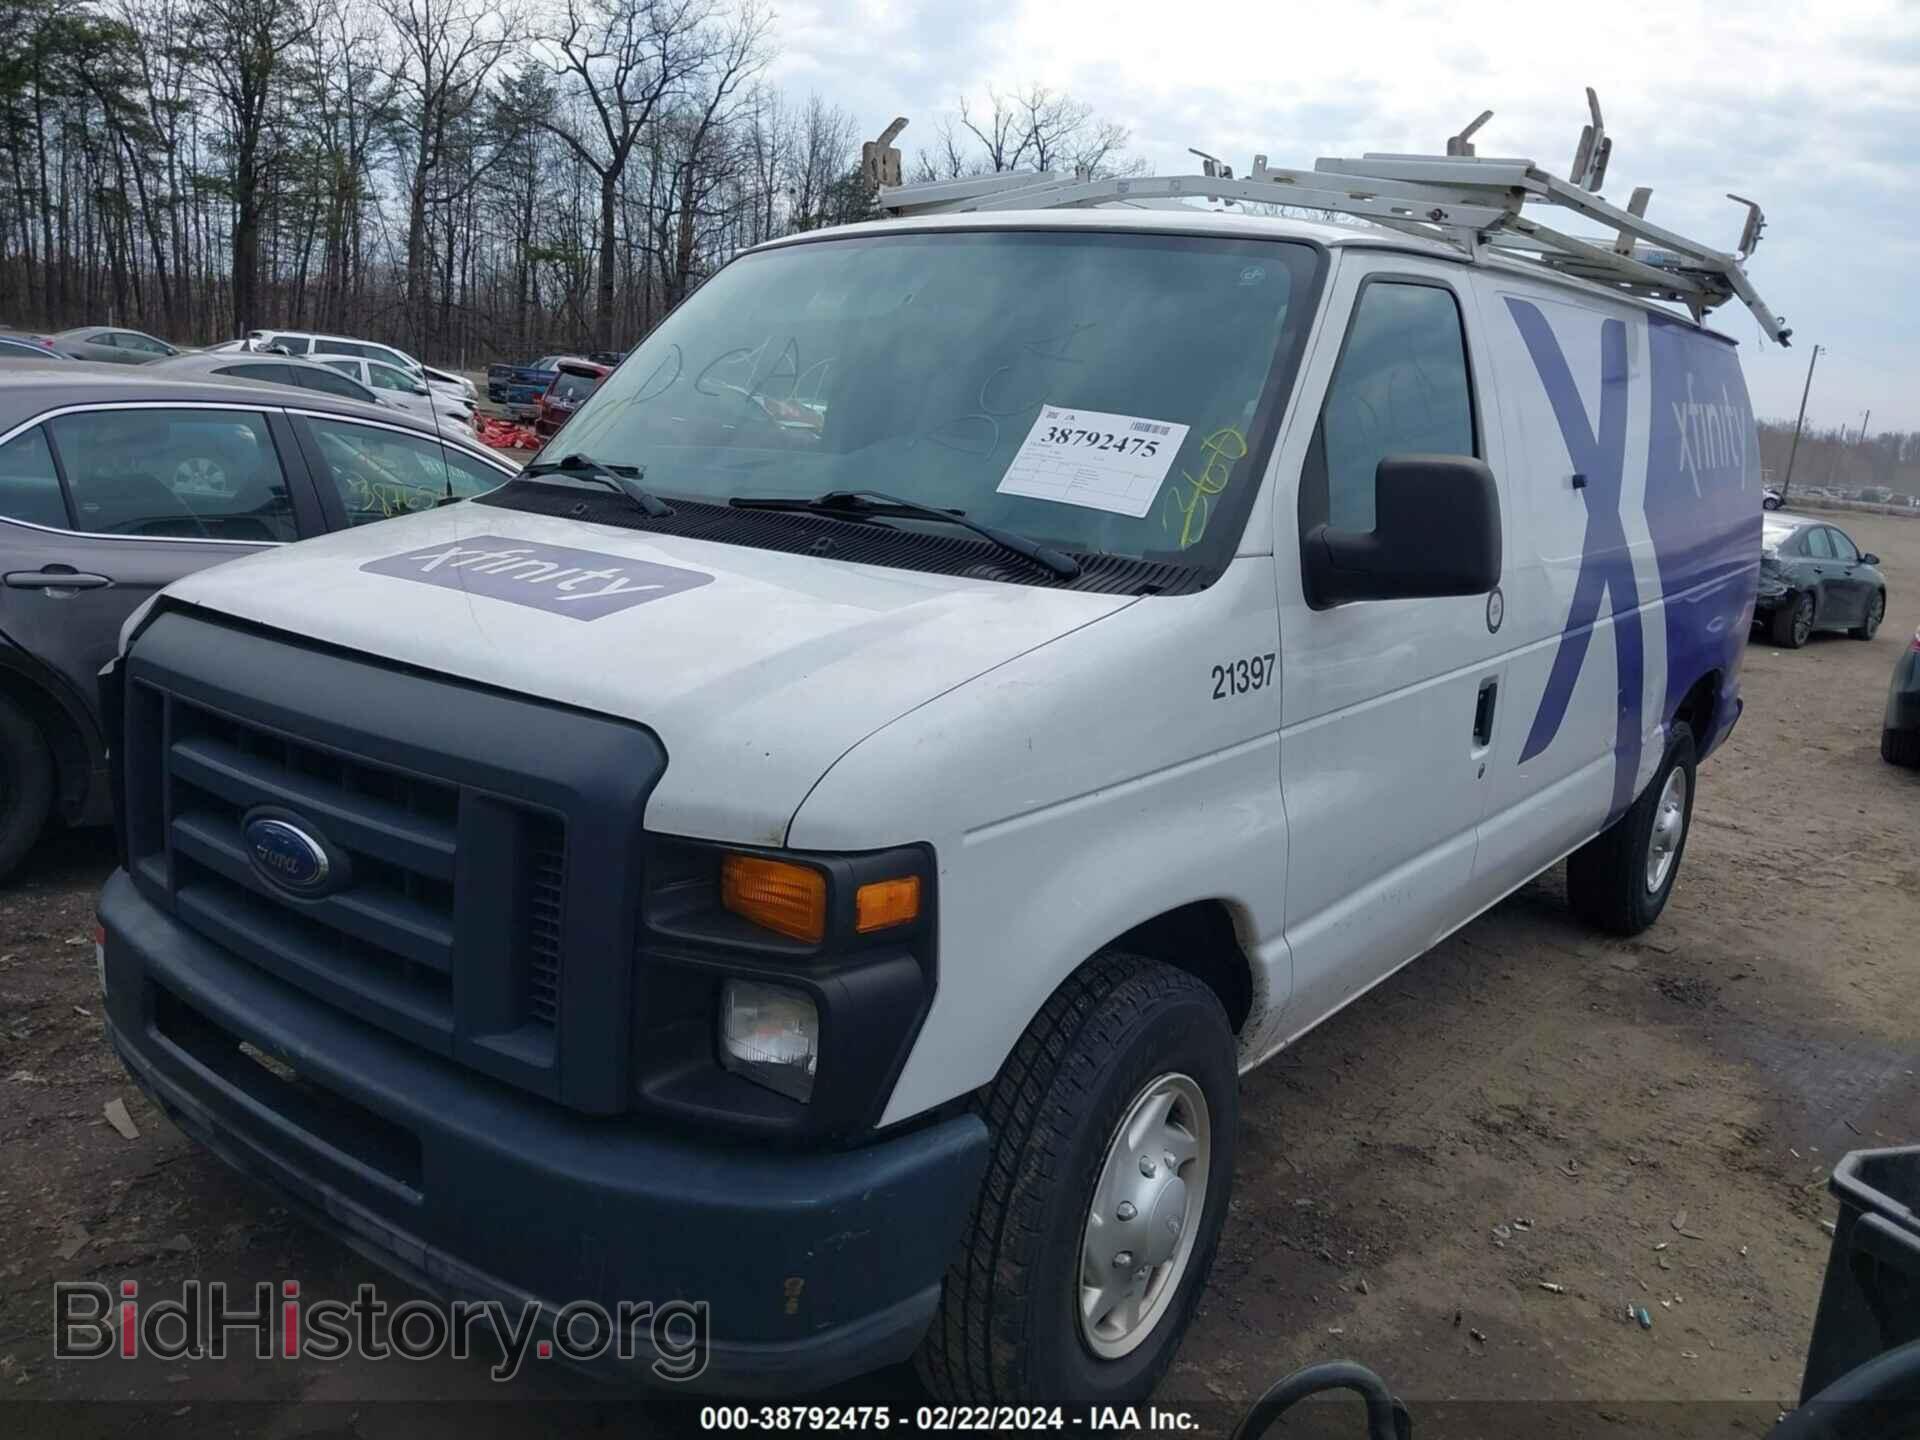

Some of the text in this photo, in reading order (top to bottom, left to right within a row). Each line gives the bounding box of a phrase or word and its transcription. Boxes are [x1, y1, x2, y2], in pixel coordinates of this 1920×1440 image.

[1041, 426, 1161, 457] 38792475
[1671, 371, 1745, 498] xfinity
[410, 546, 665, 602] xfinity
[1211, 652, 1276, 700] 21397
